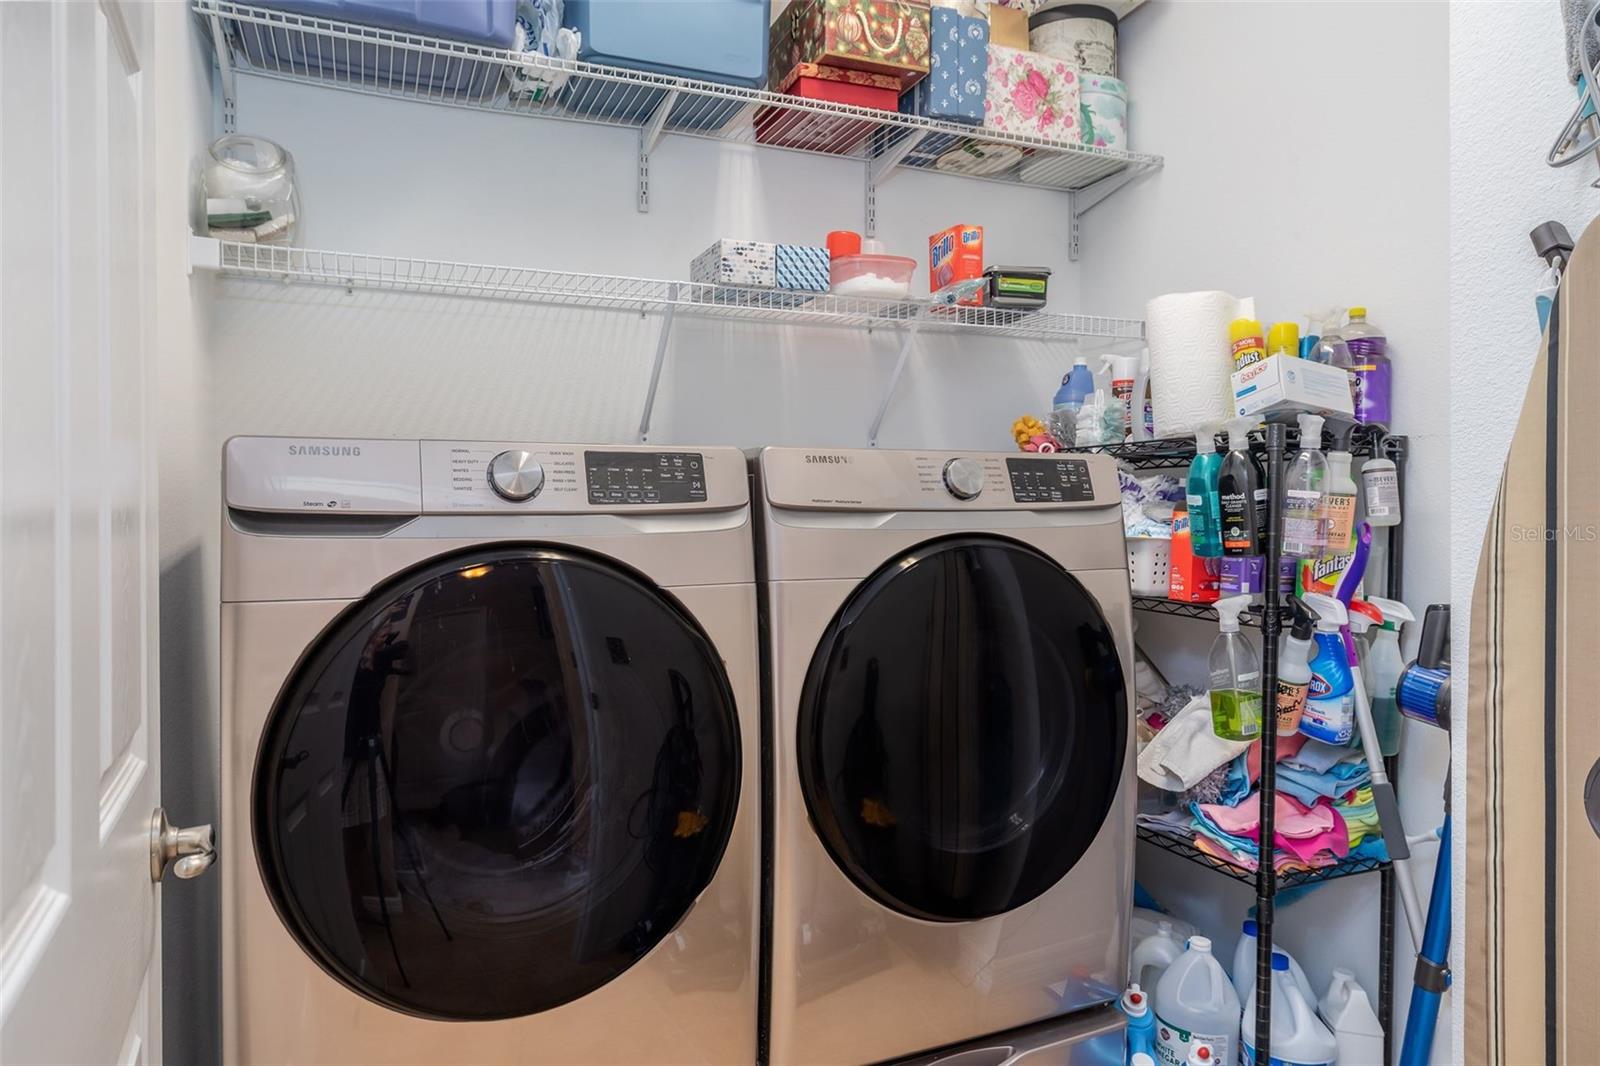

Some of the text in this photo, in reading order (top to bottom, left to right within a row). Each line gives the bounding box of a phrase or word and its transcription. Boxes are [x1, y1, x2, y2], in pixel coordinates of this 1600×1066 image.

[963, 230, 980, 243] Brillo
[932, 234, 954, 268] Brillo
[288, 444, 361, 457] SAMSUNG
[805, 454, 853, 464] SAMSUN
[1221, 492, 1246, 500] method
[1312, 554, 1356, 580] fantas
[1309, 680, 1327, 693] ROX
